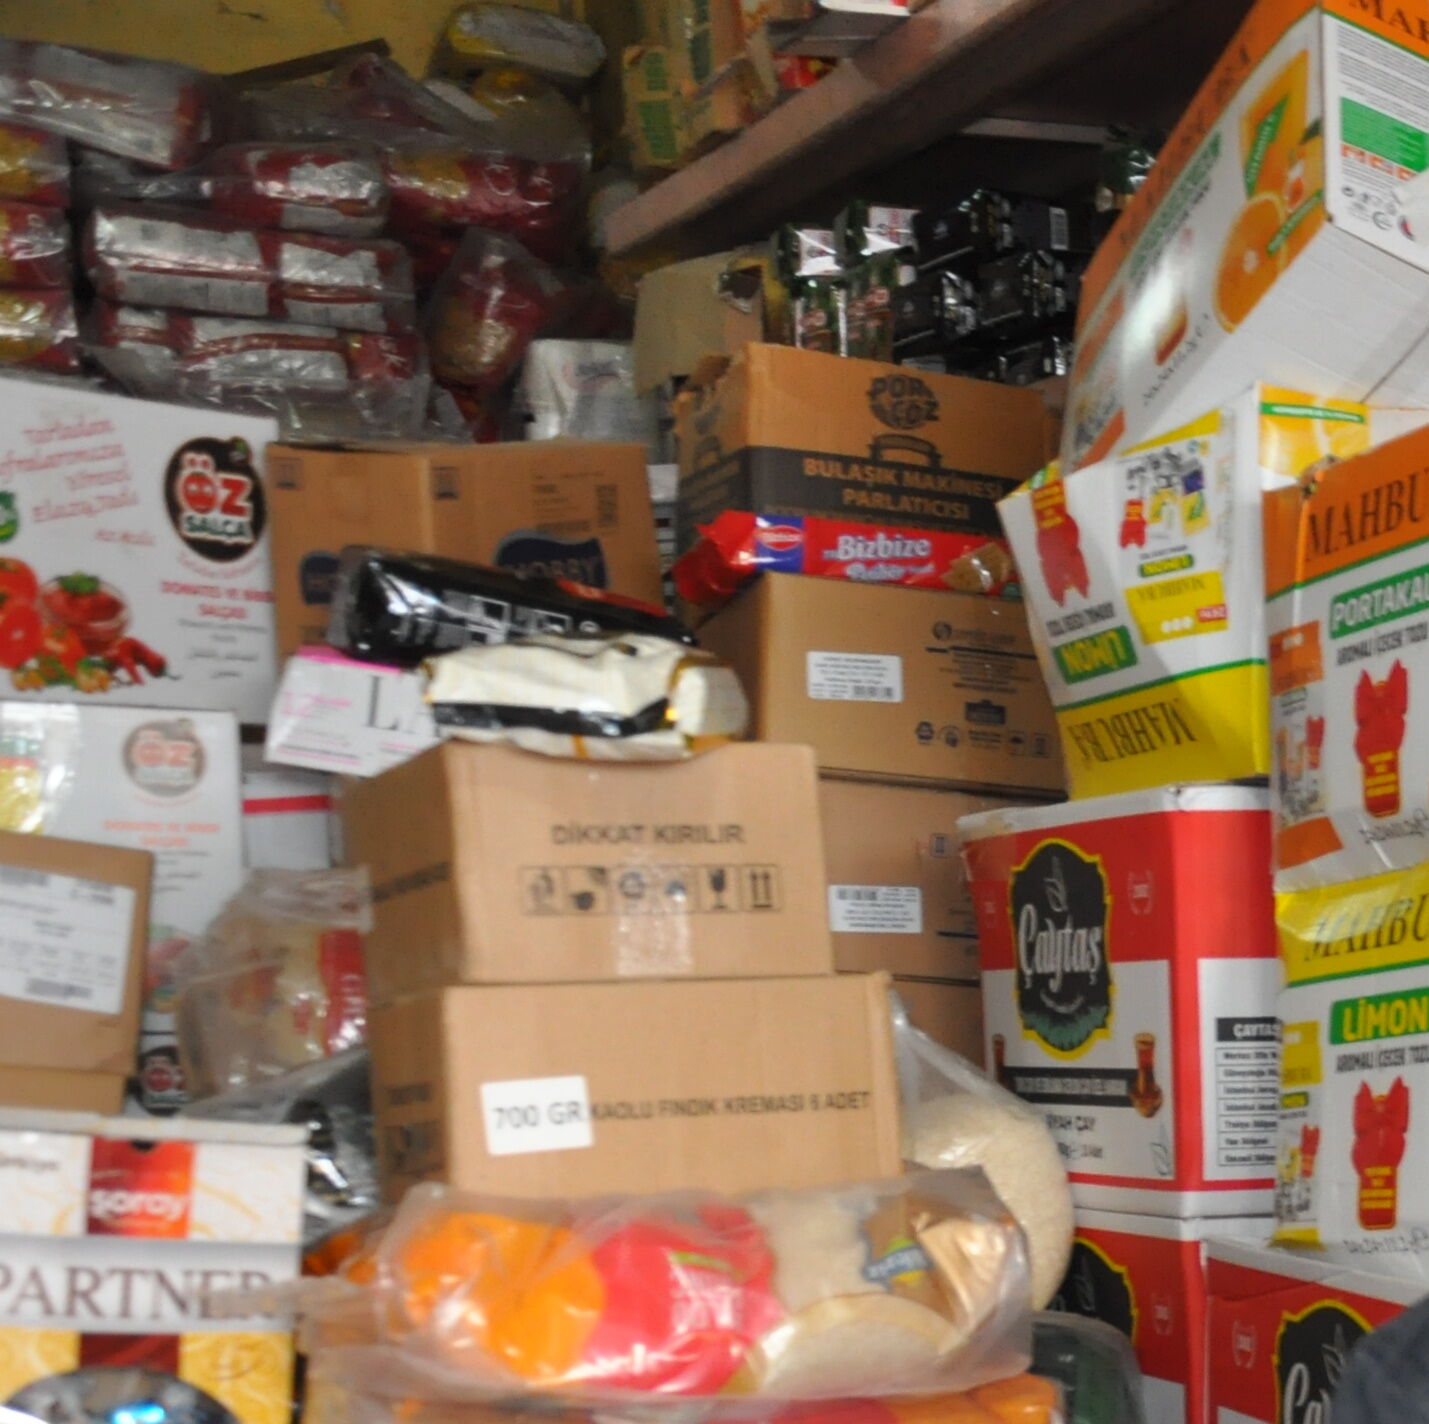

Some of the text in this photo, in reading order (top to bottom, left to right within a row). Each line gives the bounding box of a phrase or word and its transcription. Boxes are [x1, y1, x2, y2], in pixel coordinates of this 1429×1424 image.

[837, 533, 931, 561] Bizbize
[551, 822, 745, 845] DİKKAT KIRILIR
[1342, 997, 1429, 1043] LİMON
[496, 1100, 584, 1129] 700 GR
[657, 1091, 872, 1118] FINDIK KREMASI ADET
